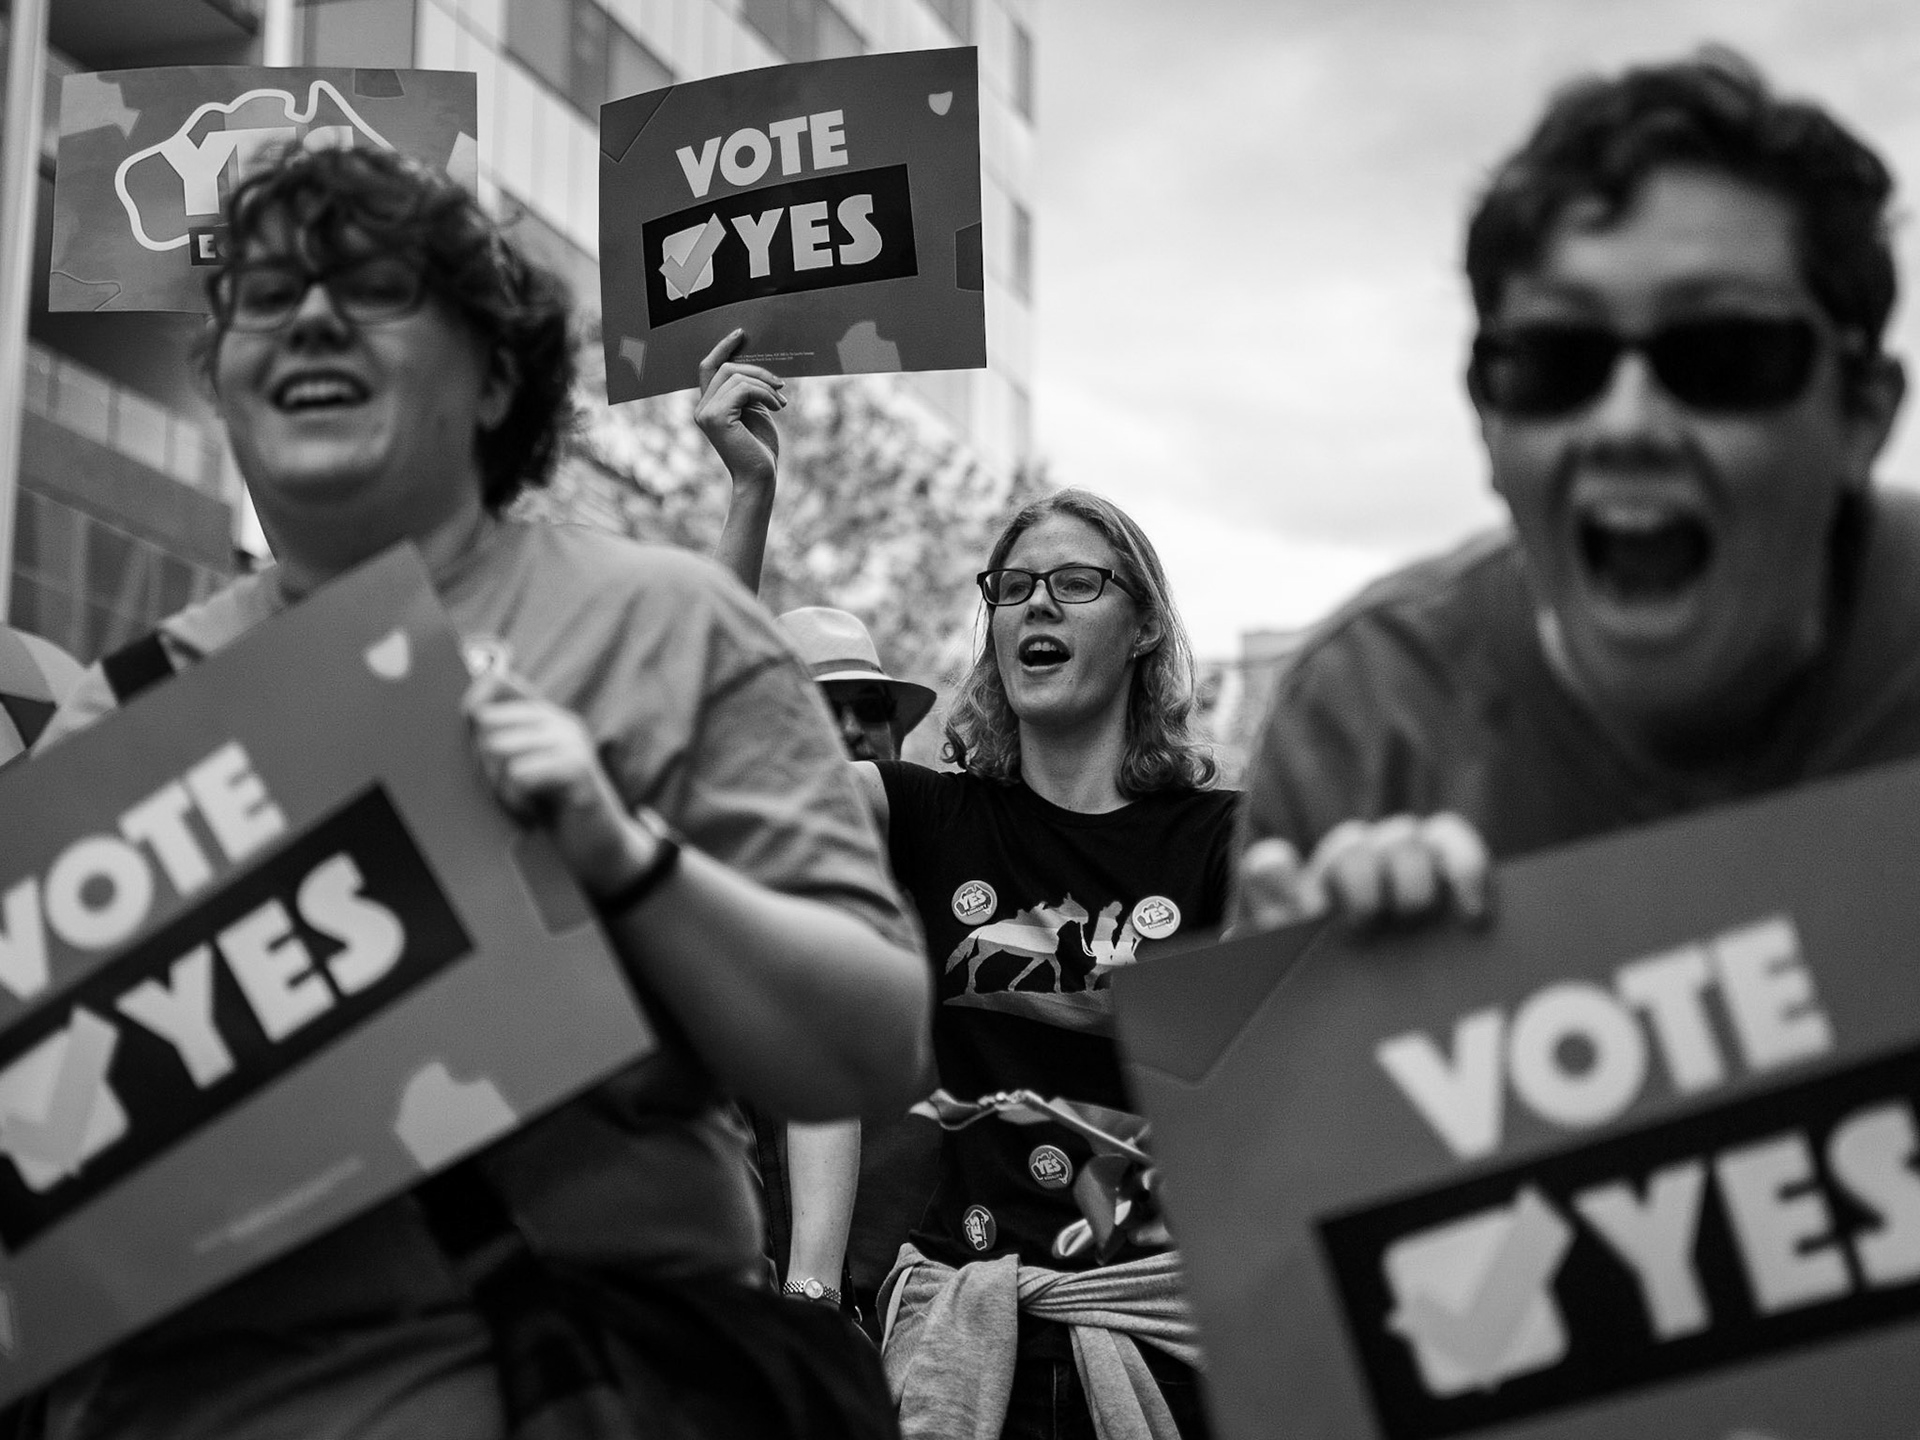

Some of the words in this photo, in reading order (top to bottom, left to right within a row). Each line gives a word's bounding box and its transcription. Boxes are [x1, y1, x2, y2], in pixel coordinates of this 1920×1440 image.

[675, 109, 849, 199] VOTE
[730, 194, 883, 279] YES
[0, 740, 288, 999] VOTE
[959, 889, 987, 910] YES
[1141, 905, 1169, 924] YES
[115, 851, 406, 1090] YES
[1375, 913, 1834, 1162] VOTE
[1037, 1158, 1061, 1175] YES
[969, 1216, 983, 1243] YES
[1573, 1103, 1920, 1343] YES
